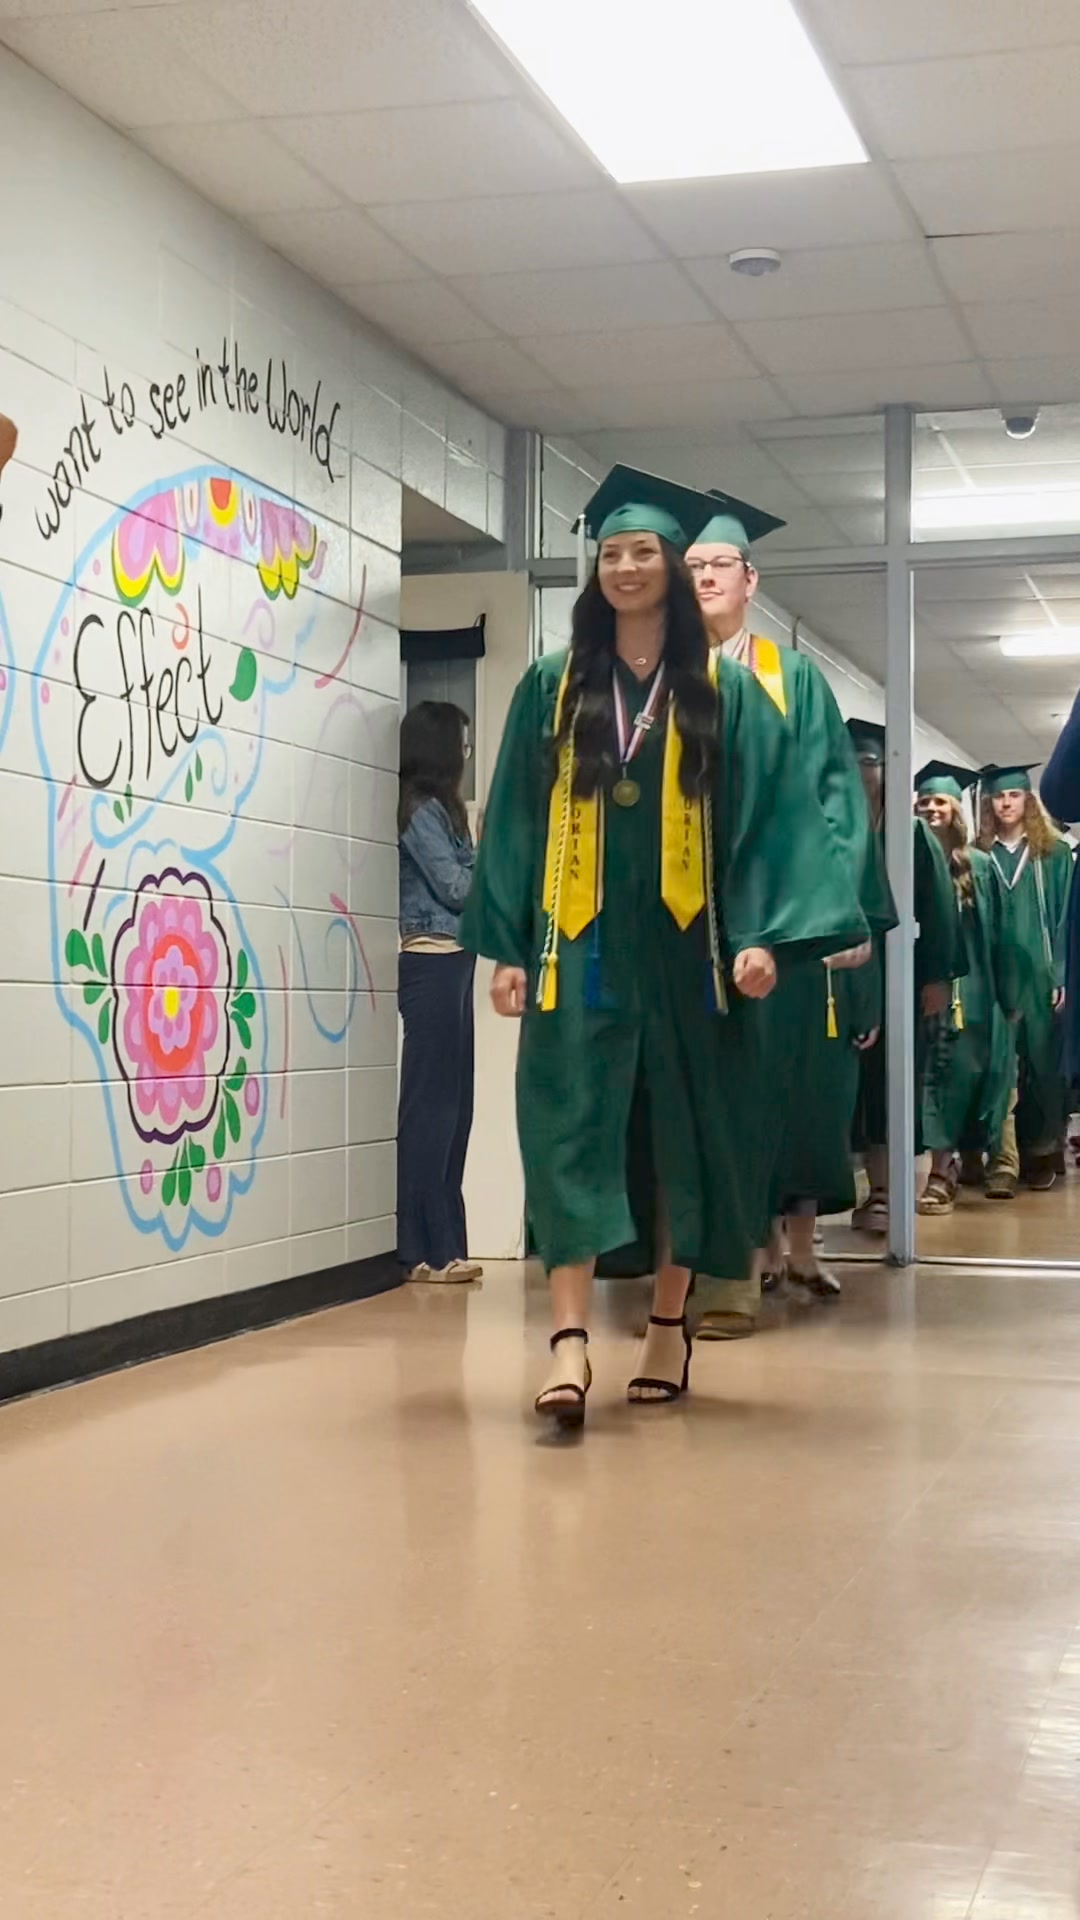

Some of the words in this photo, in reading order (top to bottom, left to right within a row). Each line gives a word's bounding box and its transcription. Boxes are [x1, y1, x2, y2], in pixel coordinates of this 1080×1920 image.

[35, 394, 102, 541] want
[102, 365, 136, 435] to
[149, 374, 191, 439] see
[196, 347, 217, 412] in
[218, 337, 259, 414] the
[73, 583, 223, 789] Effect
